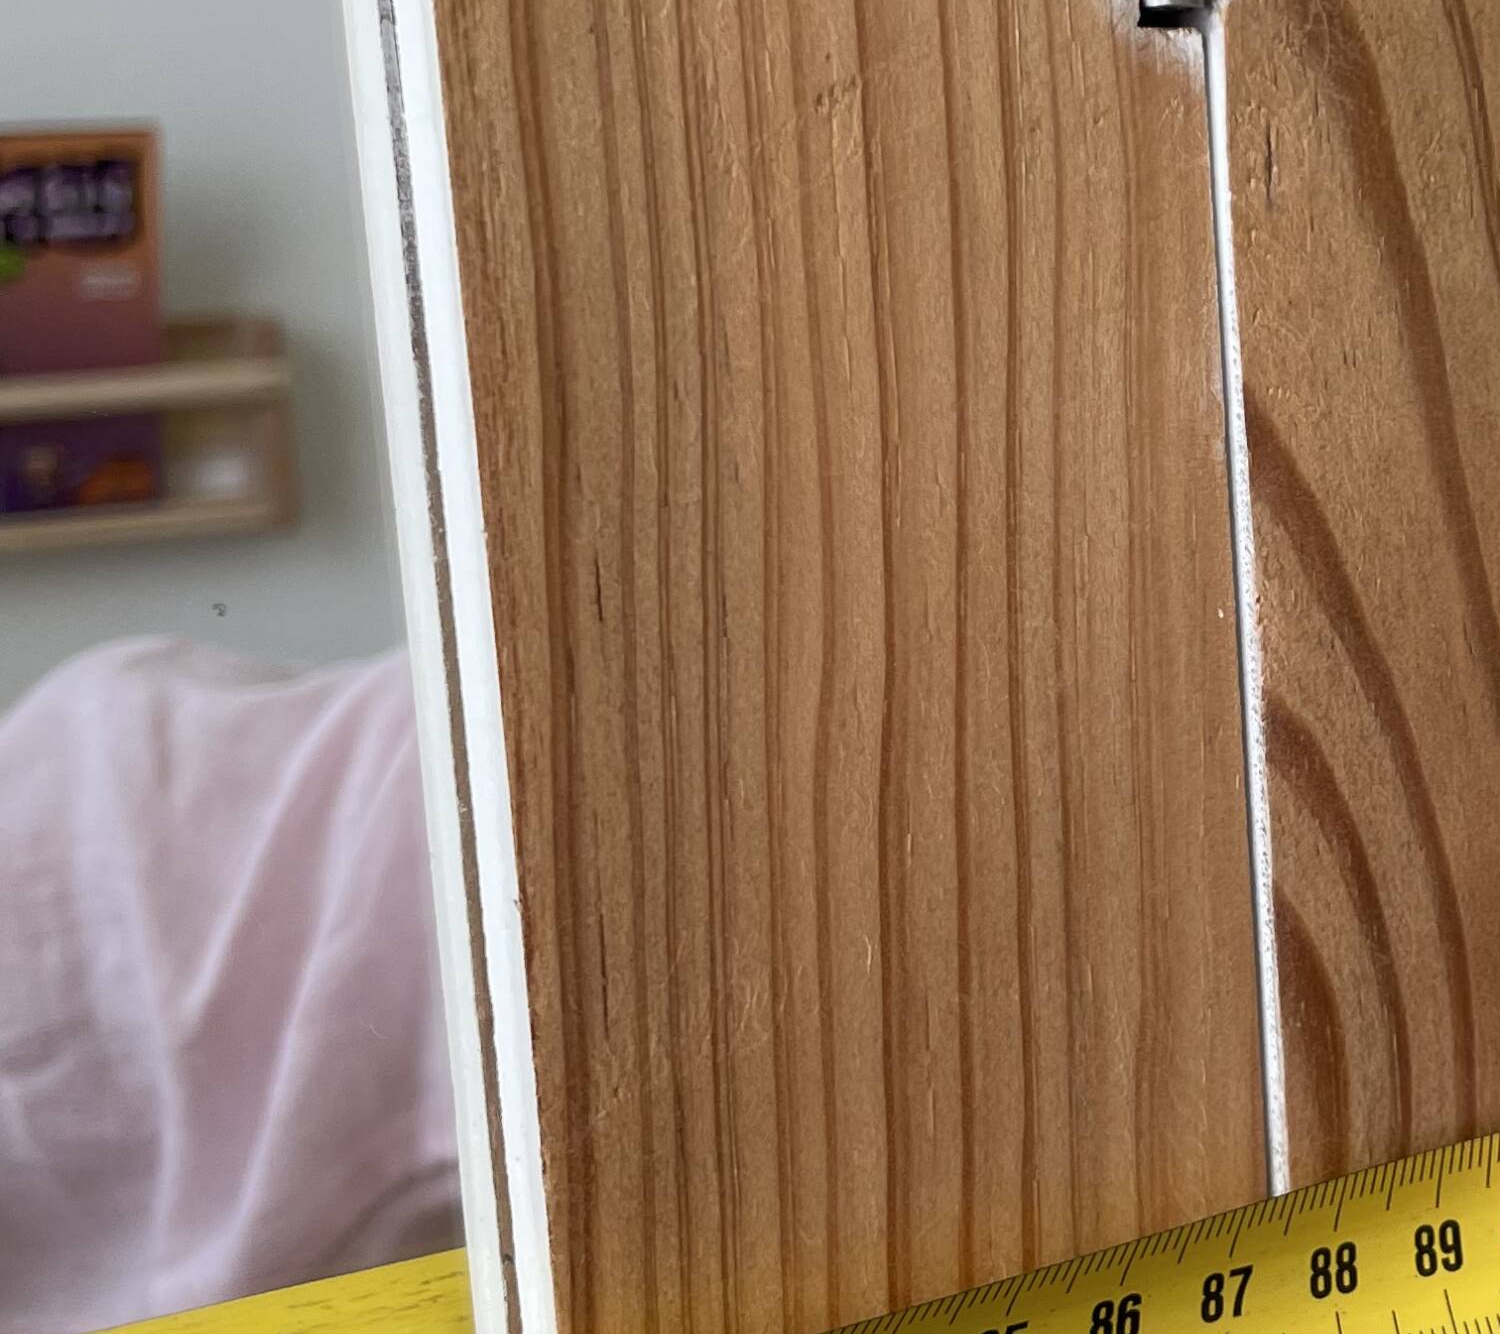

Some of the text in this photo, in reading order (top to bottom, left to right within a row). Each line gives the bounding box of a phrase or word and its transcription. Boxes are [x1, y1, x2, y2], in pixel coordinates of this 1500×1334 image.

[1201, 1264, 1253, 1323] 87
[1310, 1242, 1358, 1299] 88
[1415, 1220, 1463, 1277] 89
